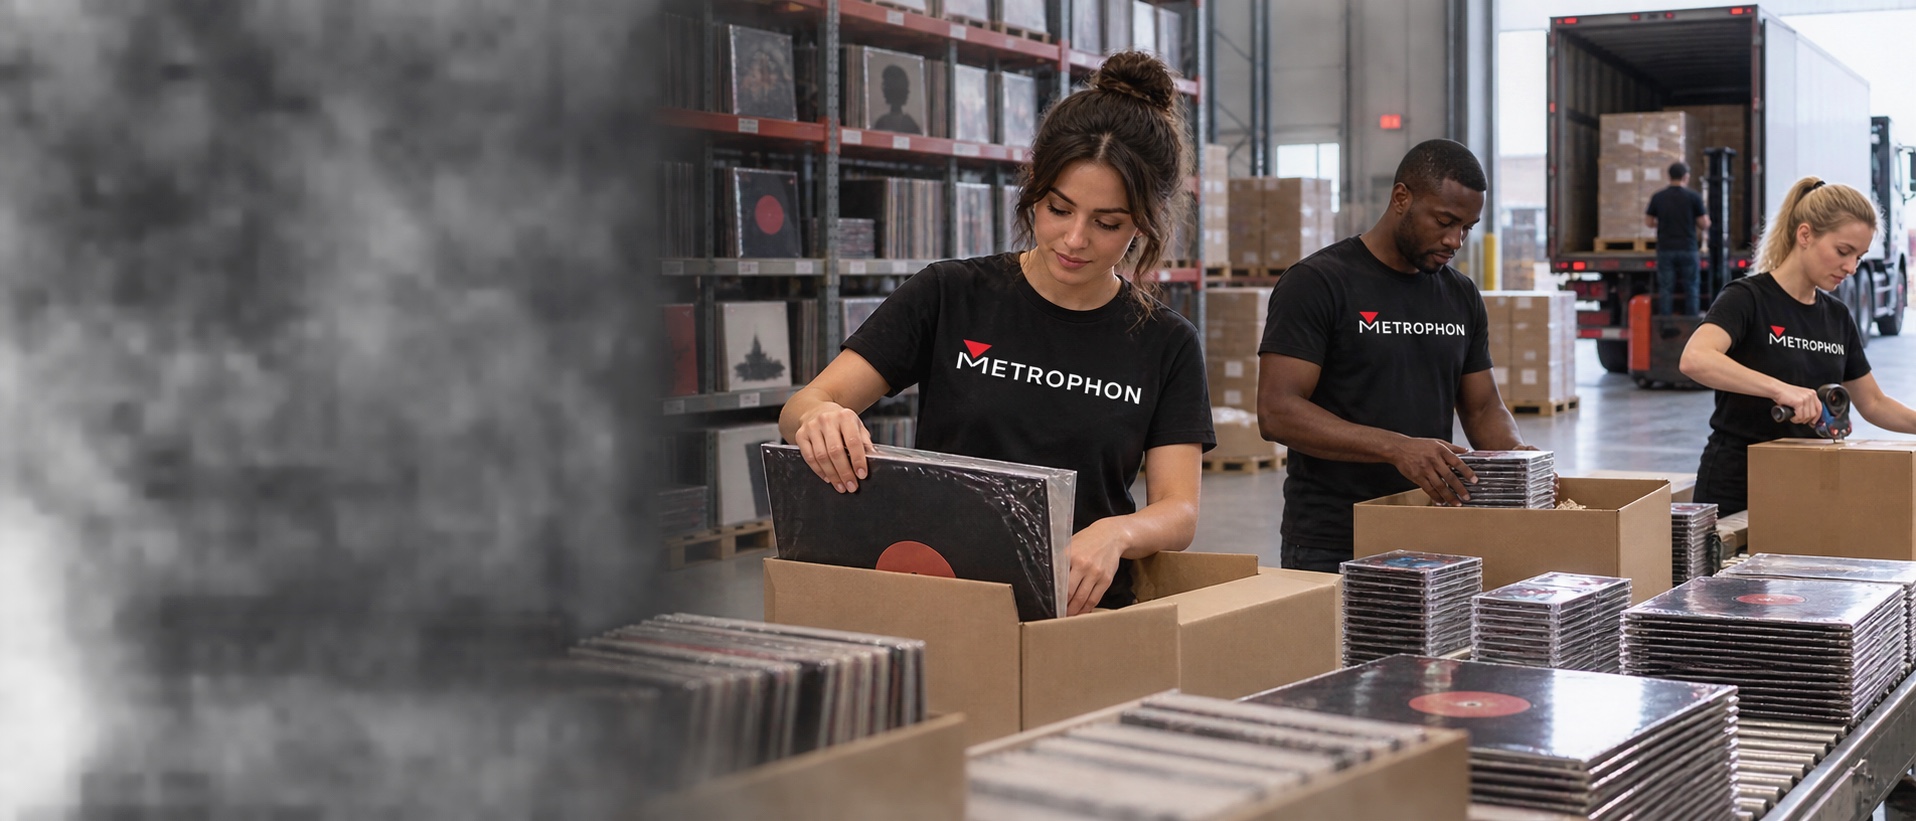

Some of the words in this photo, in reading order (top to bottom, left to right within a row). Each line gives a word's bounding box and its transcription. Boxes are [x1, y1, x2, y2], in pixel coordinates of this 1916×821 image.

[1359, 319, 1465, 336] METROPHON
[1769, 332, 1845, 355] METROPHON
[956, 351, 1142, 405] METROPHON
